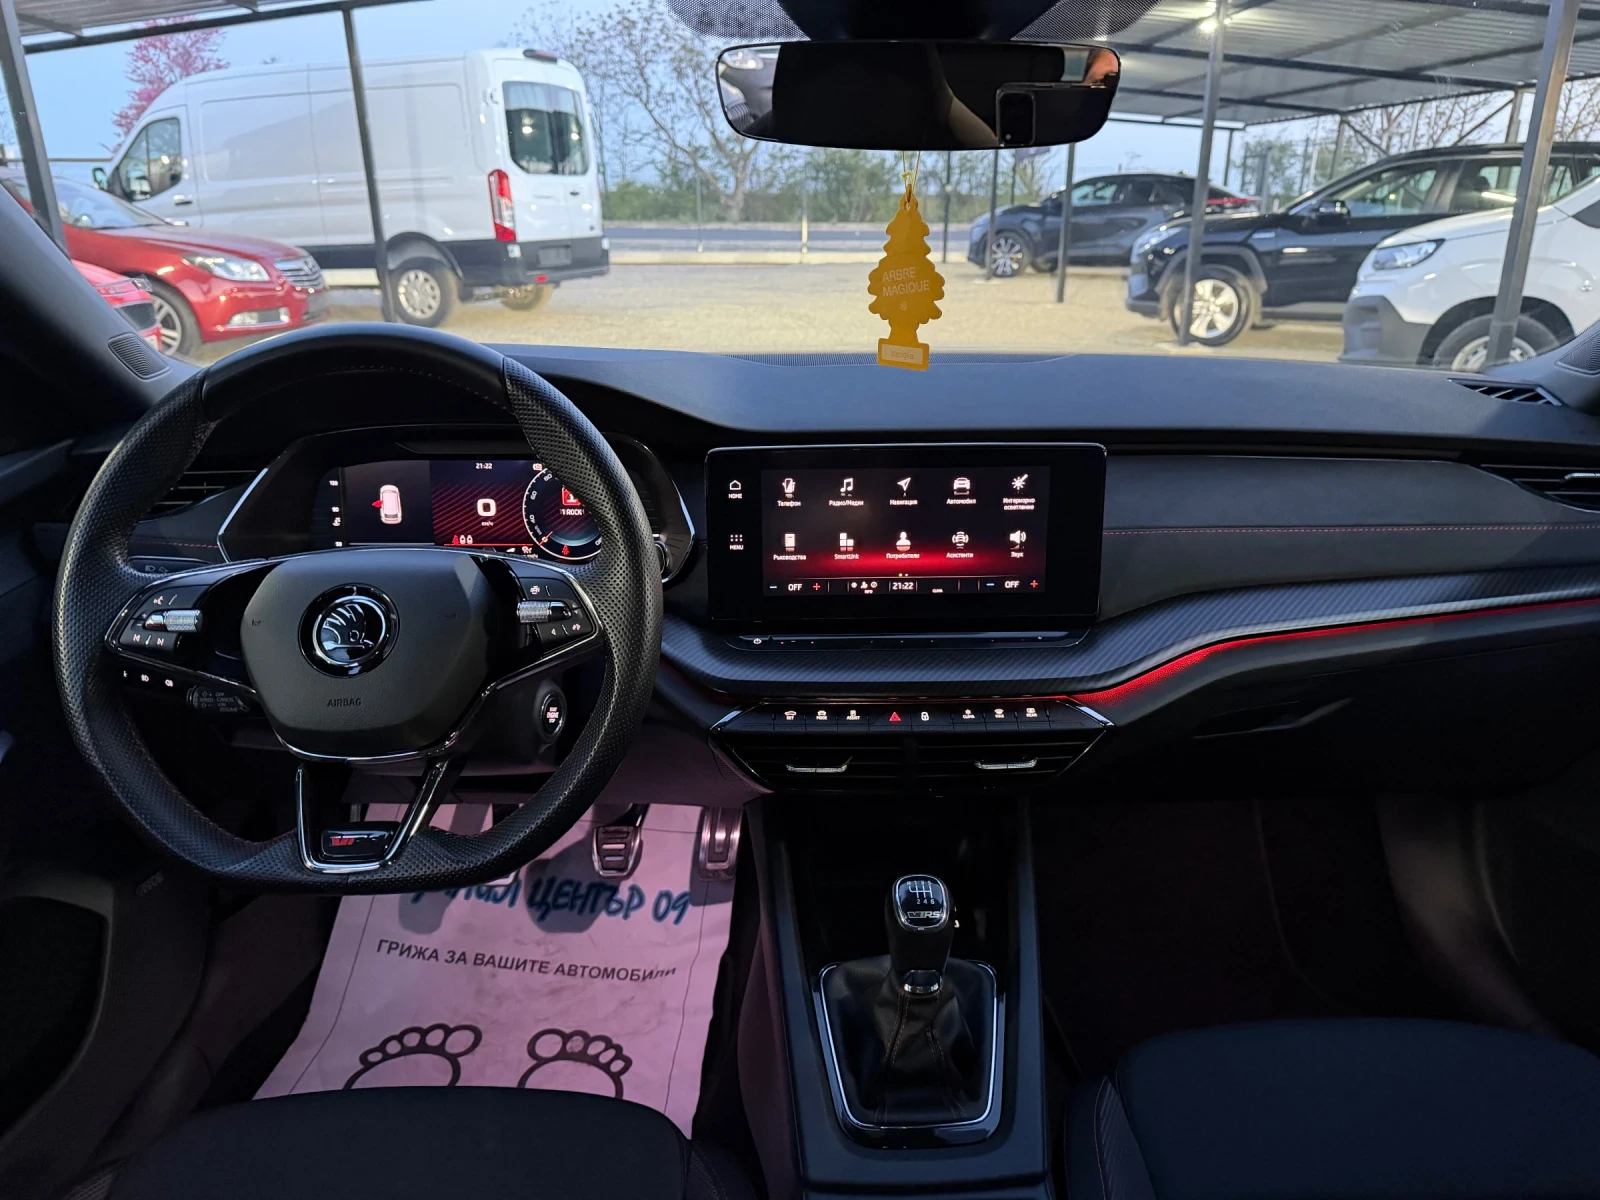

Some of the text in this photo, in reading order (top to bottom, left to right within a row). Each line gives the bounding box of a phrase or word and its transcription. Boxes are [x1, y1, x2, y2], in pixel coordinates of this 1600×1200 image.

[882, 266, 916, 283] ARBRE
[882, 280, 931, 297] MAGIQUE
[475, 462, 493, 470] 21:22
[477, 498, 497, 517] 0
[777, 500, 802, 508] Телефон
[787, 583, 803, 591] OFF
[892, 582, 914, 590] 21:22
[1004, 580, 1020, 588] OFF
[327, 697, 362, 708] AIRBAG
[527, 876, 646, 922] ЦЕНТЪР
[652, 889, 691, 925] 09
[376, 939, 440, 962] ГРИЖА
[444, 950, 468, 965] ЗА
[473, 953, 551, 974] ВАШИТЕ
